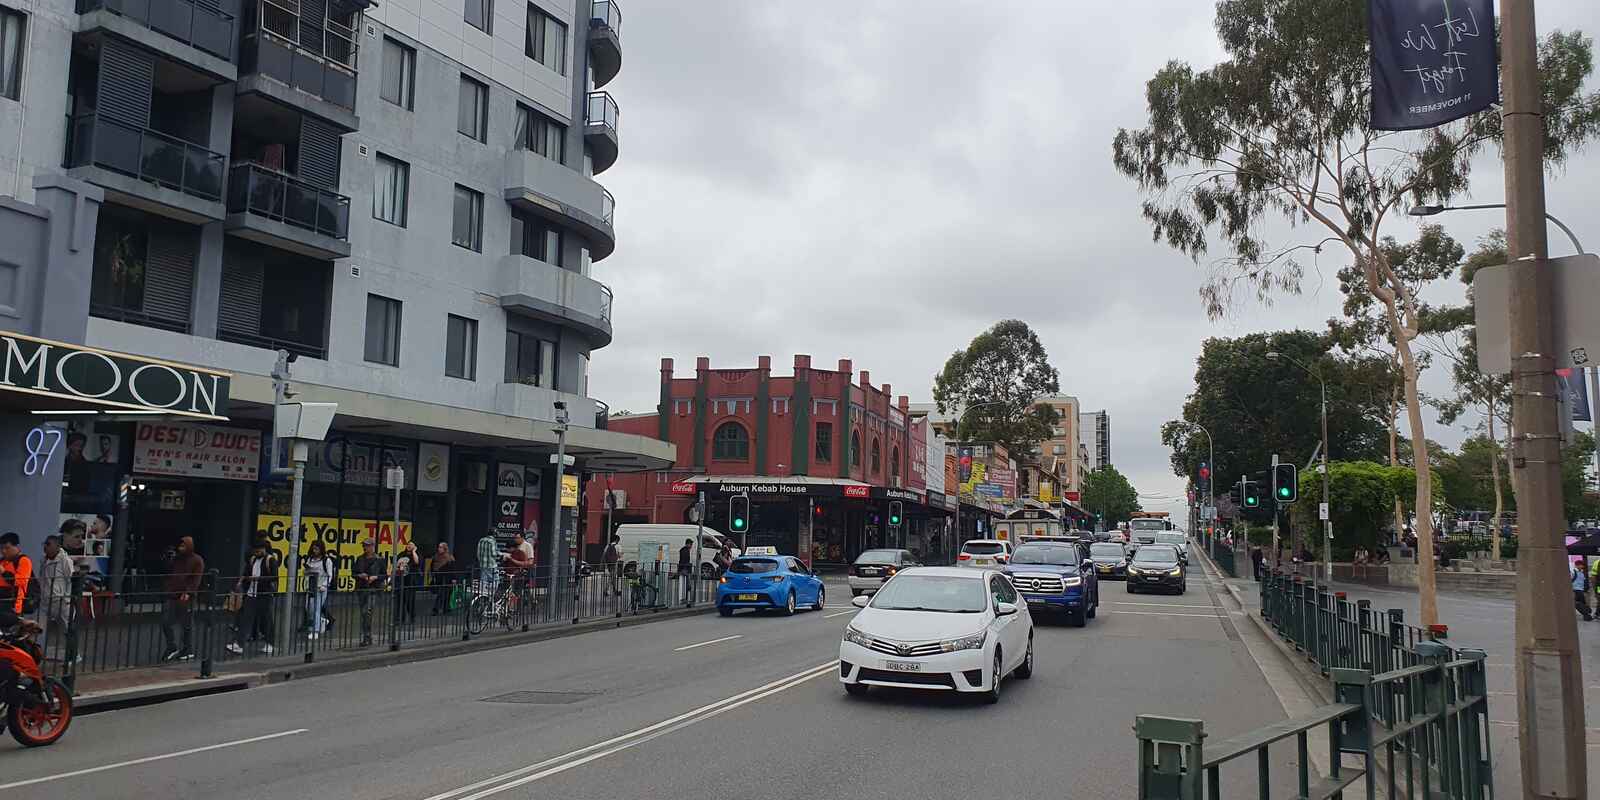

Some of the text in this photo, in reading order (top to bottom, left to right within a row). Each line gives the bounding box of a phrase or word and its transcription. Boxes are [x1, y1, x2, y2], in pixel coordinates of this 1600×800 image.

[1, 336, 221, 416] MOON
[138, 424, 186, 445] DESI
[210, 431, 259, 452] DUDE
[24, 428, 62, 476] 87
[147, 448, 247, 465] MEN'S HAIR SALON
[719, 484, 807, 493] Auburn Kebab House
[501, 501, 519, 516] OZ
[313, 522, 361, 544] Your
[364, 522, 409, 546] TAX
